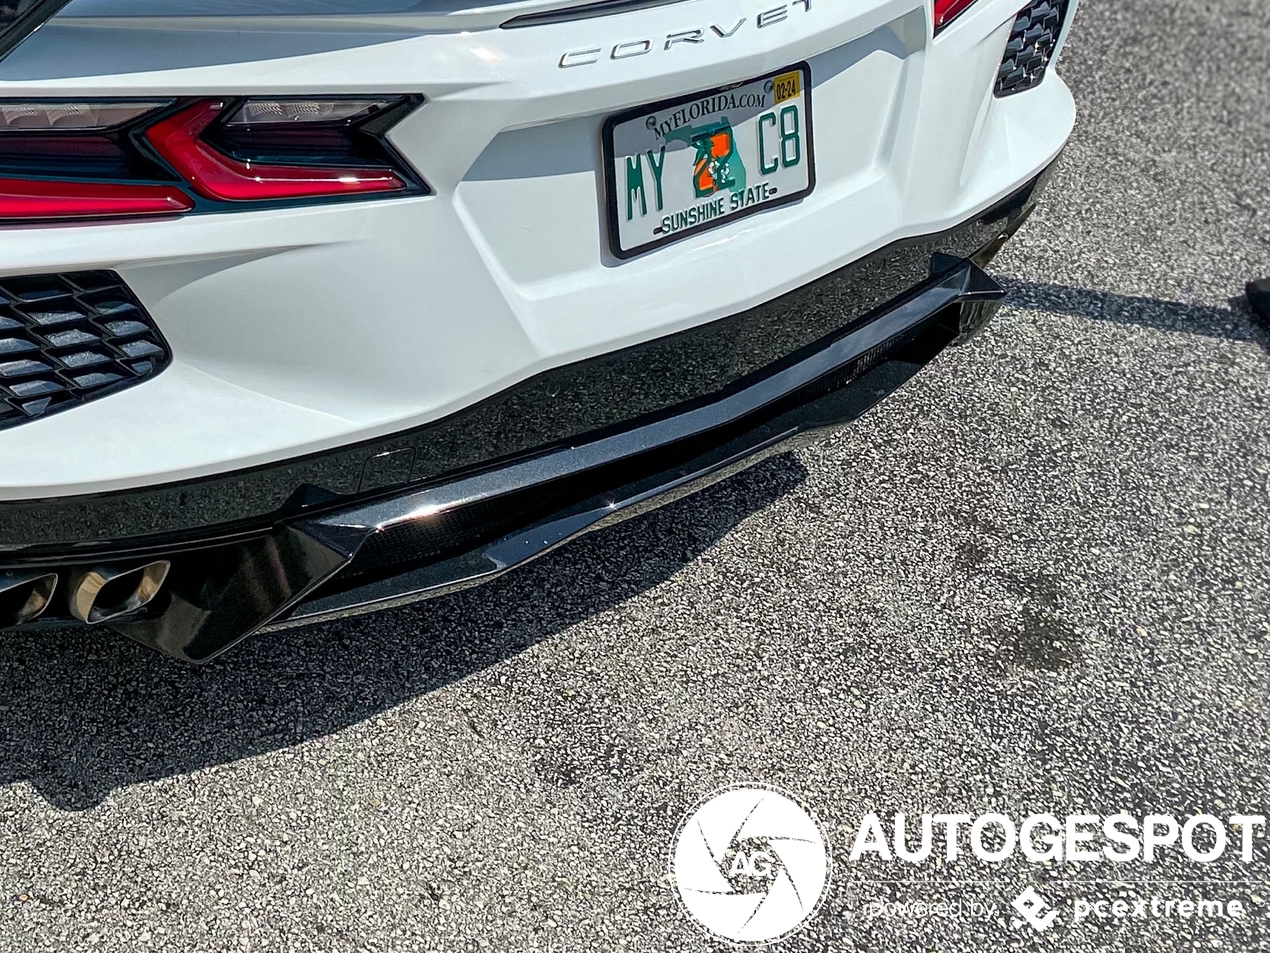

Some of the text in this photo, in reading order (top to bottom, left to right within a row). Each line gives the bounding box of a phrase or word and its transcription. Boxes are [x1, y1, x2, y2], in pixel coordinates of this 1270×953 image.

[776, 79, 796, 101] 02-24
[626, 104, 802, 221] MY C8
[661, 182, 770, 234] SUNSHINE STATE
